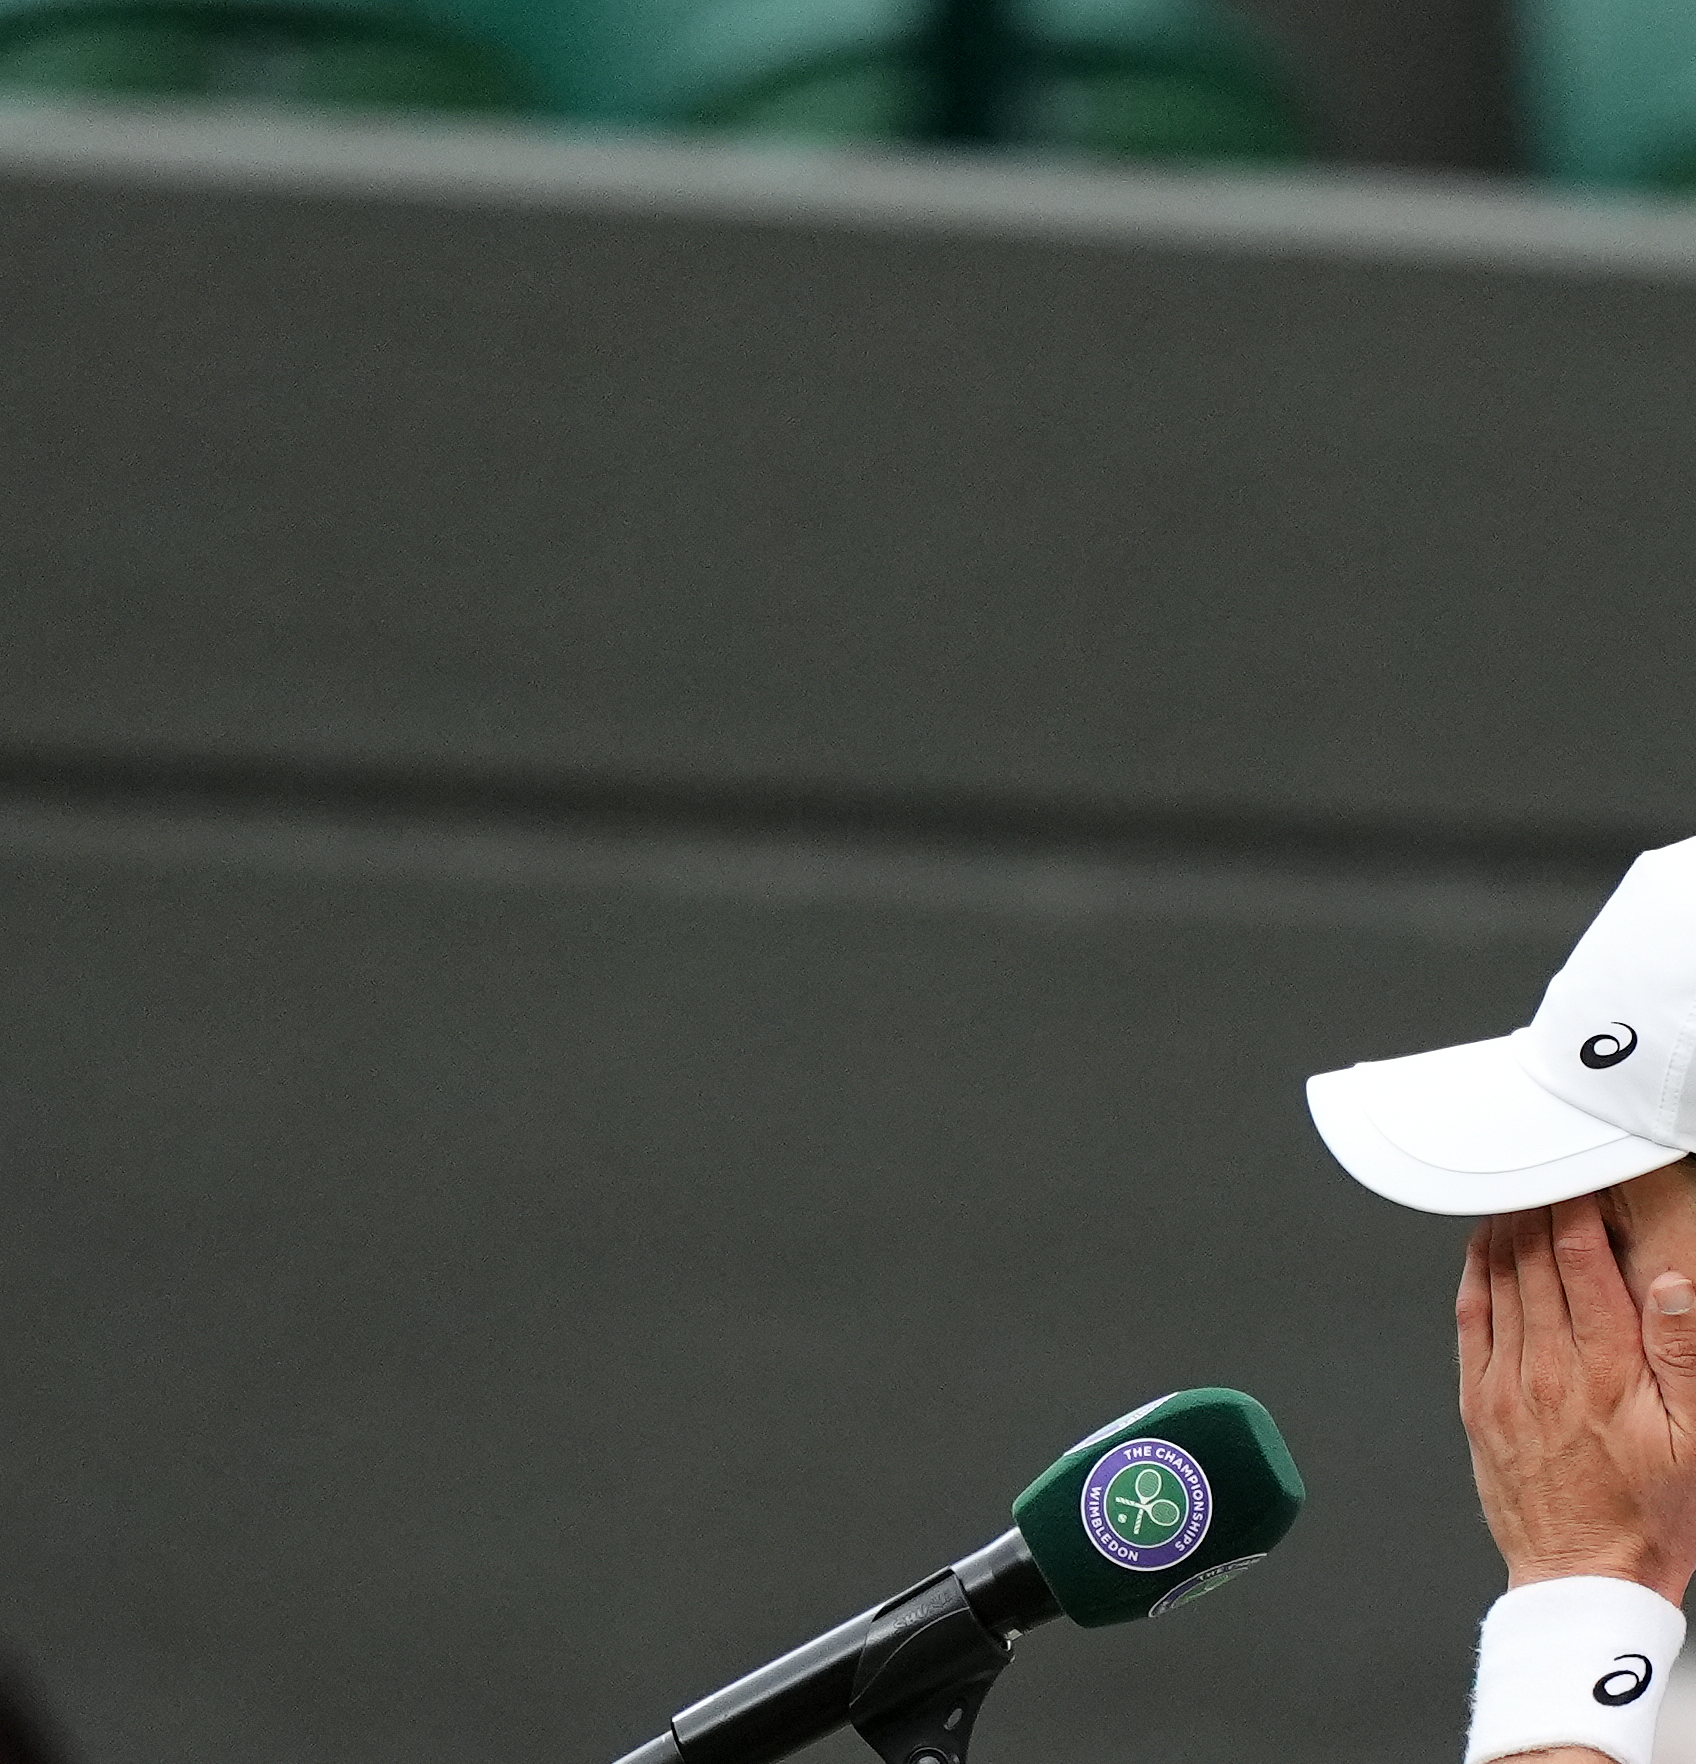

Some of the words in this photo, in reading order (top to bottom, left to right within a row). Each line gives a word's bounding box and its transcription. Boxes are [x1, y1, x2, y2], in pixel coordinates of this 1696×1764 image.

[1089, 1486, 1139, 1562] WIMBLEDON
[1123, 1445, 1152, 1462] THE
[1155, 1447, 1205, 1552] CHAMPIONSHIPS
